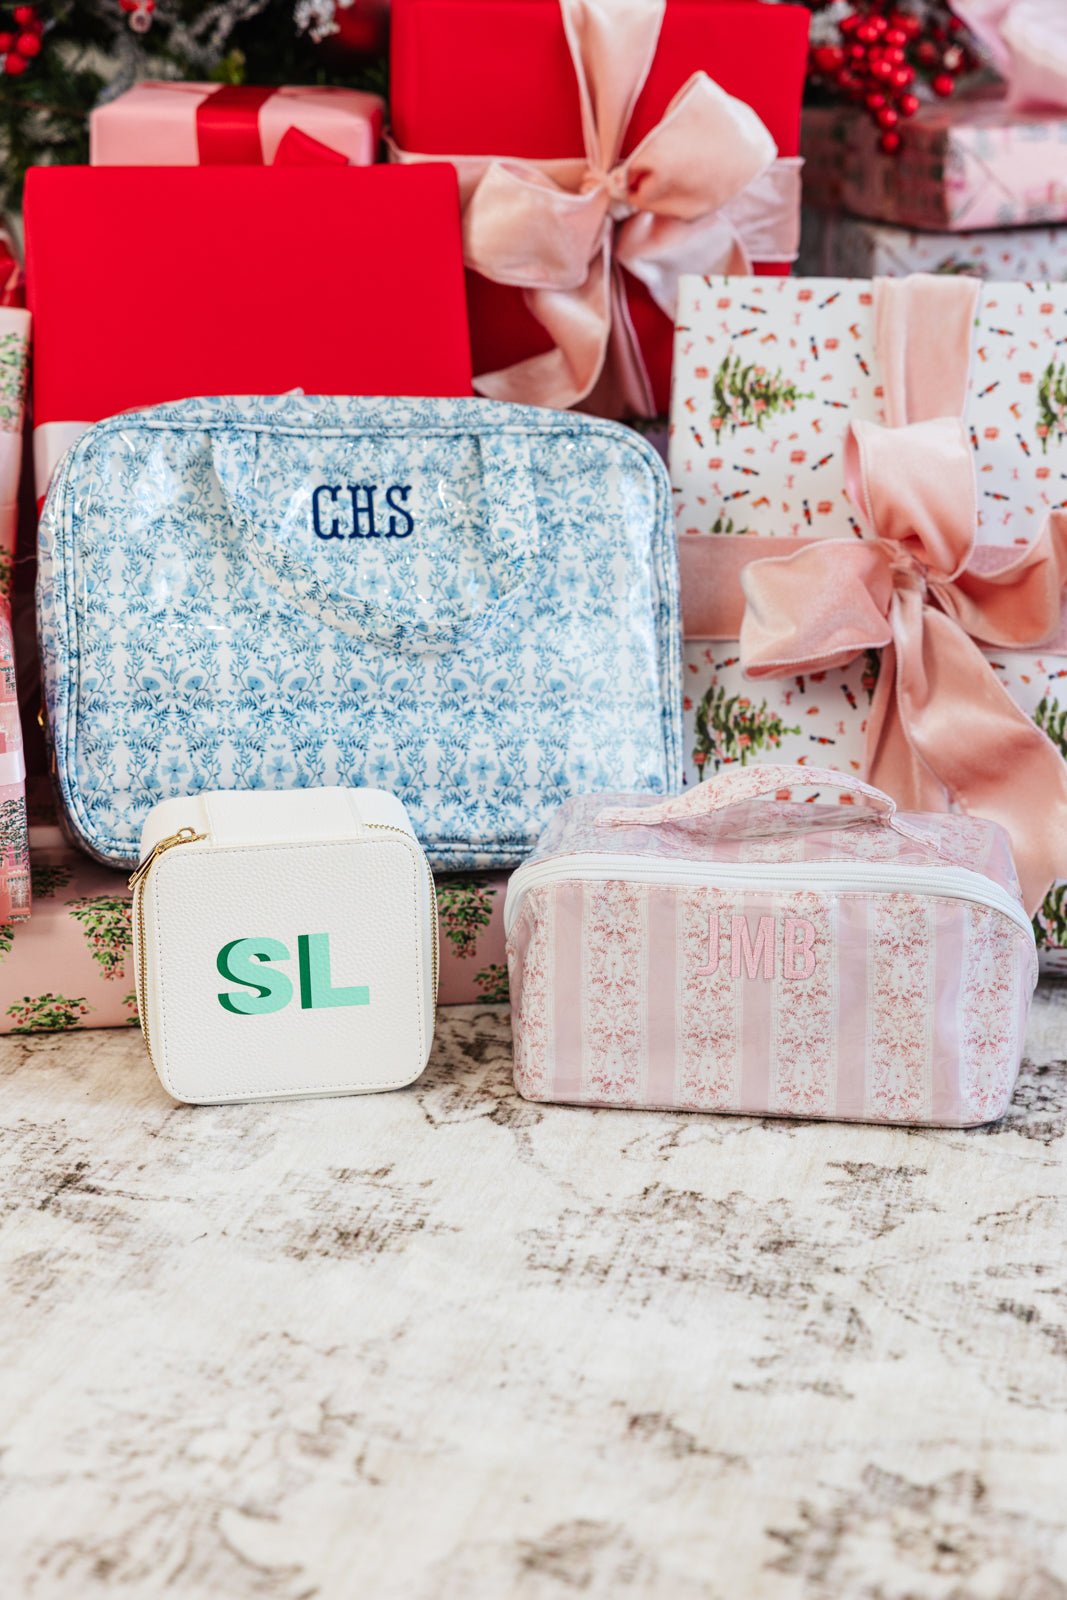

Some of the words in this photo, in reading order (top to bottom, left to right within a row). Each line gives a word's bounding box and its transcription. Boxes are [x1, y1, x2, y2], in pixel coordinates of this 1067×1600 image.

[312, 485, 414, 540] CHS
[216, 932, 370, 1015] SL
[696, 914, 817, 980] JMB
